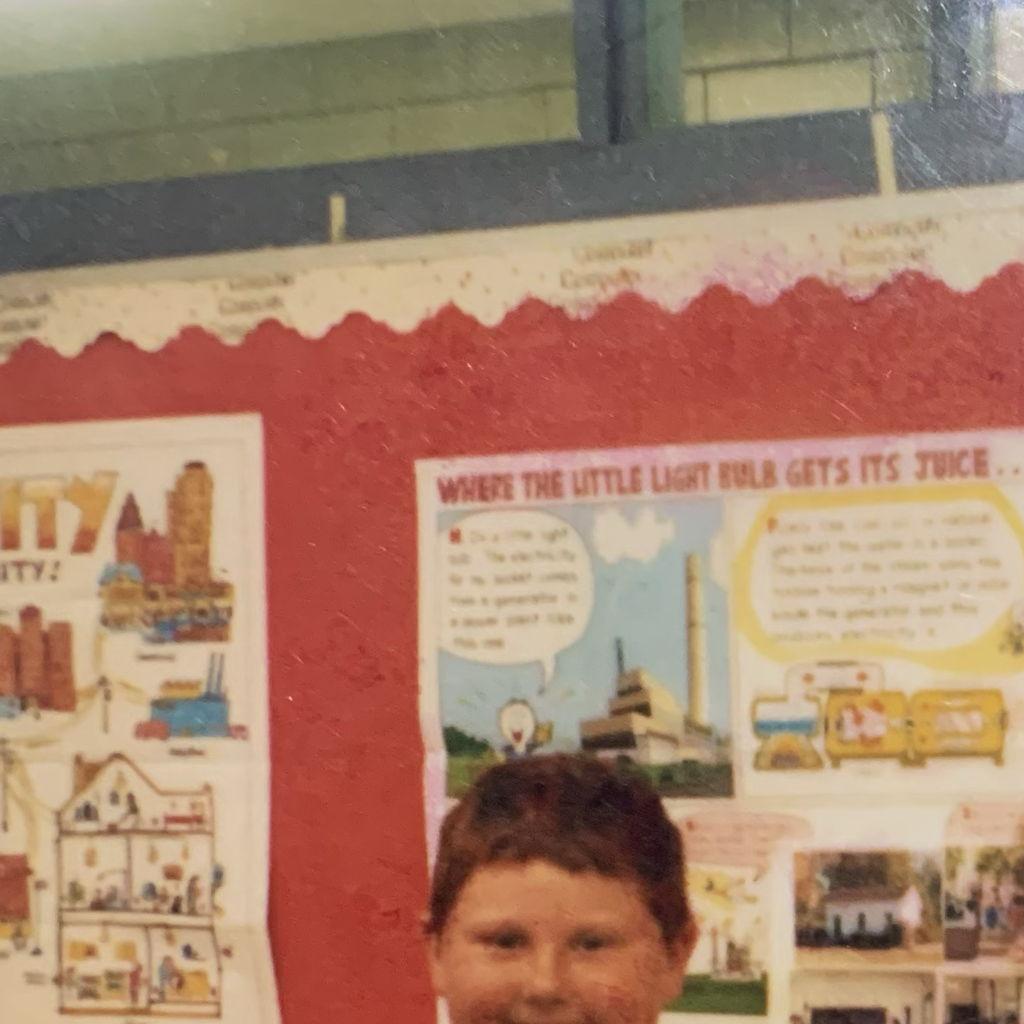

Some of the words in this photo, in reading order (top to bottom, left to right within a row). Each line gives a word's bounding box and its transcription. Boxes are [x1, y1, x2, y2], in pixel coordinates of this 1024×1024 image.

[437, 472, 514, 504] WHERE
[521, 468, 563, 500] THE
[571, 464, 643, 498] LITTLE
[650, 460, 711, 493] LIGHT
[718, 458, 777, 490] BULB
[786, 455, 849, 488] GETS
[859, 452, 899, 484] ITS
